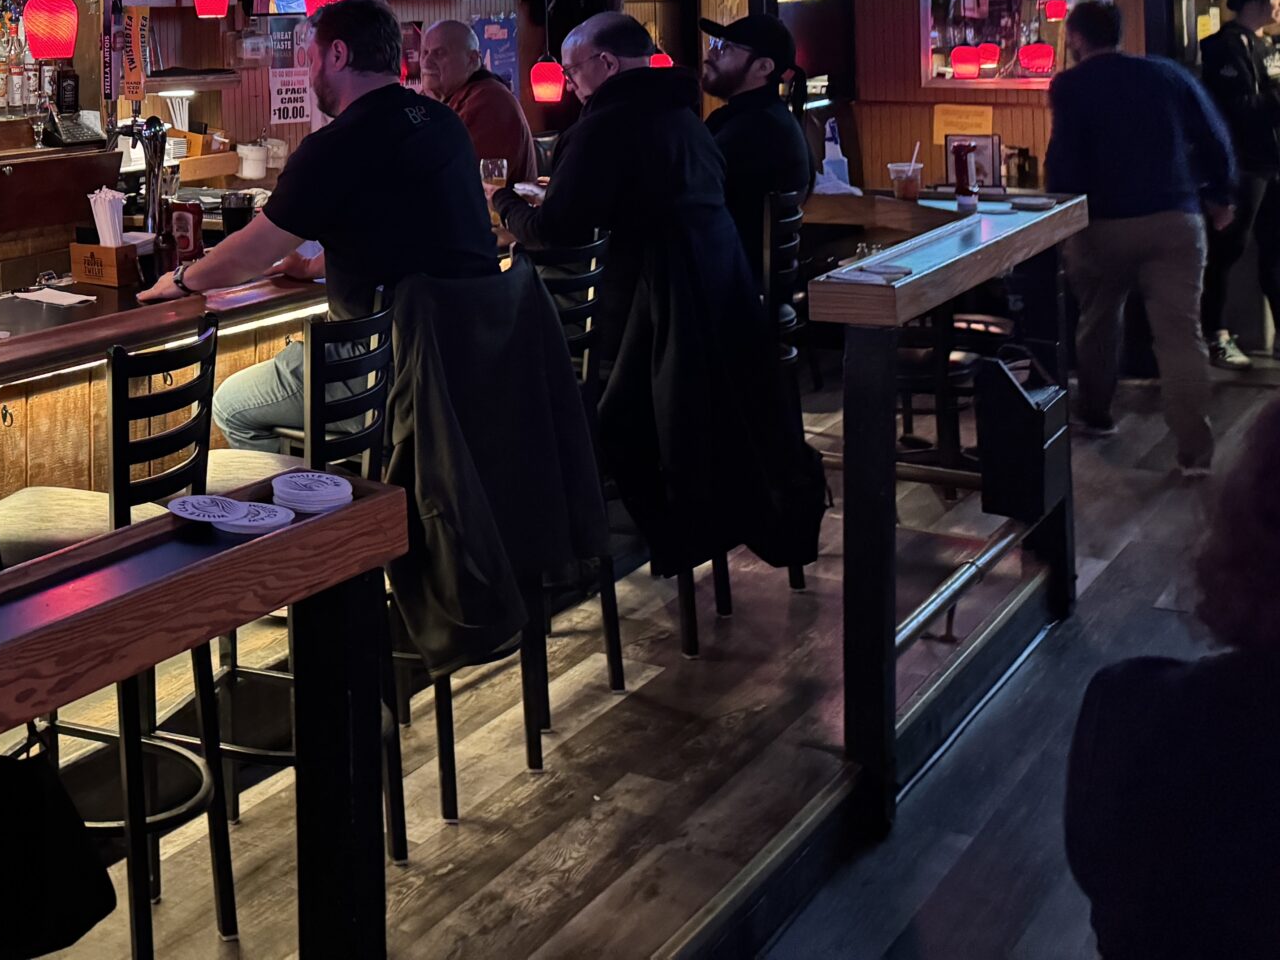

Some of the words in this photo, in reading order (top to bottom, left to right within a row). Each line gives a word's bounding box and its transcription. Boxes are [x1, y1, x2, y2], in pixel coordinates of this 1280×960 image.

[124, 15, 134, 31] TEA
[124, 33, 138, 73] TWISTED
[285, 87, 308, 96] PACK
[280, 96, 305, 105] CANS
[273, 105, 305, 120] $10.00
